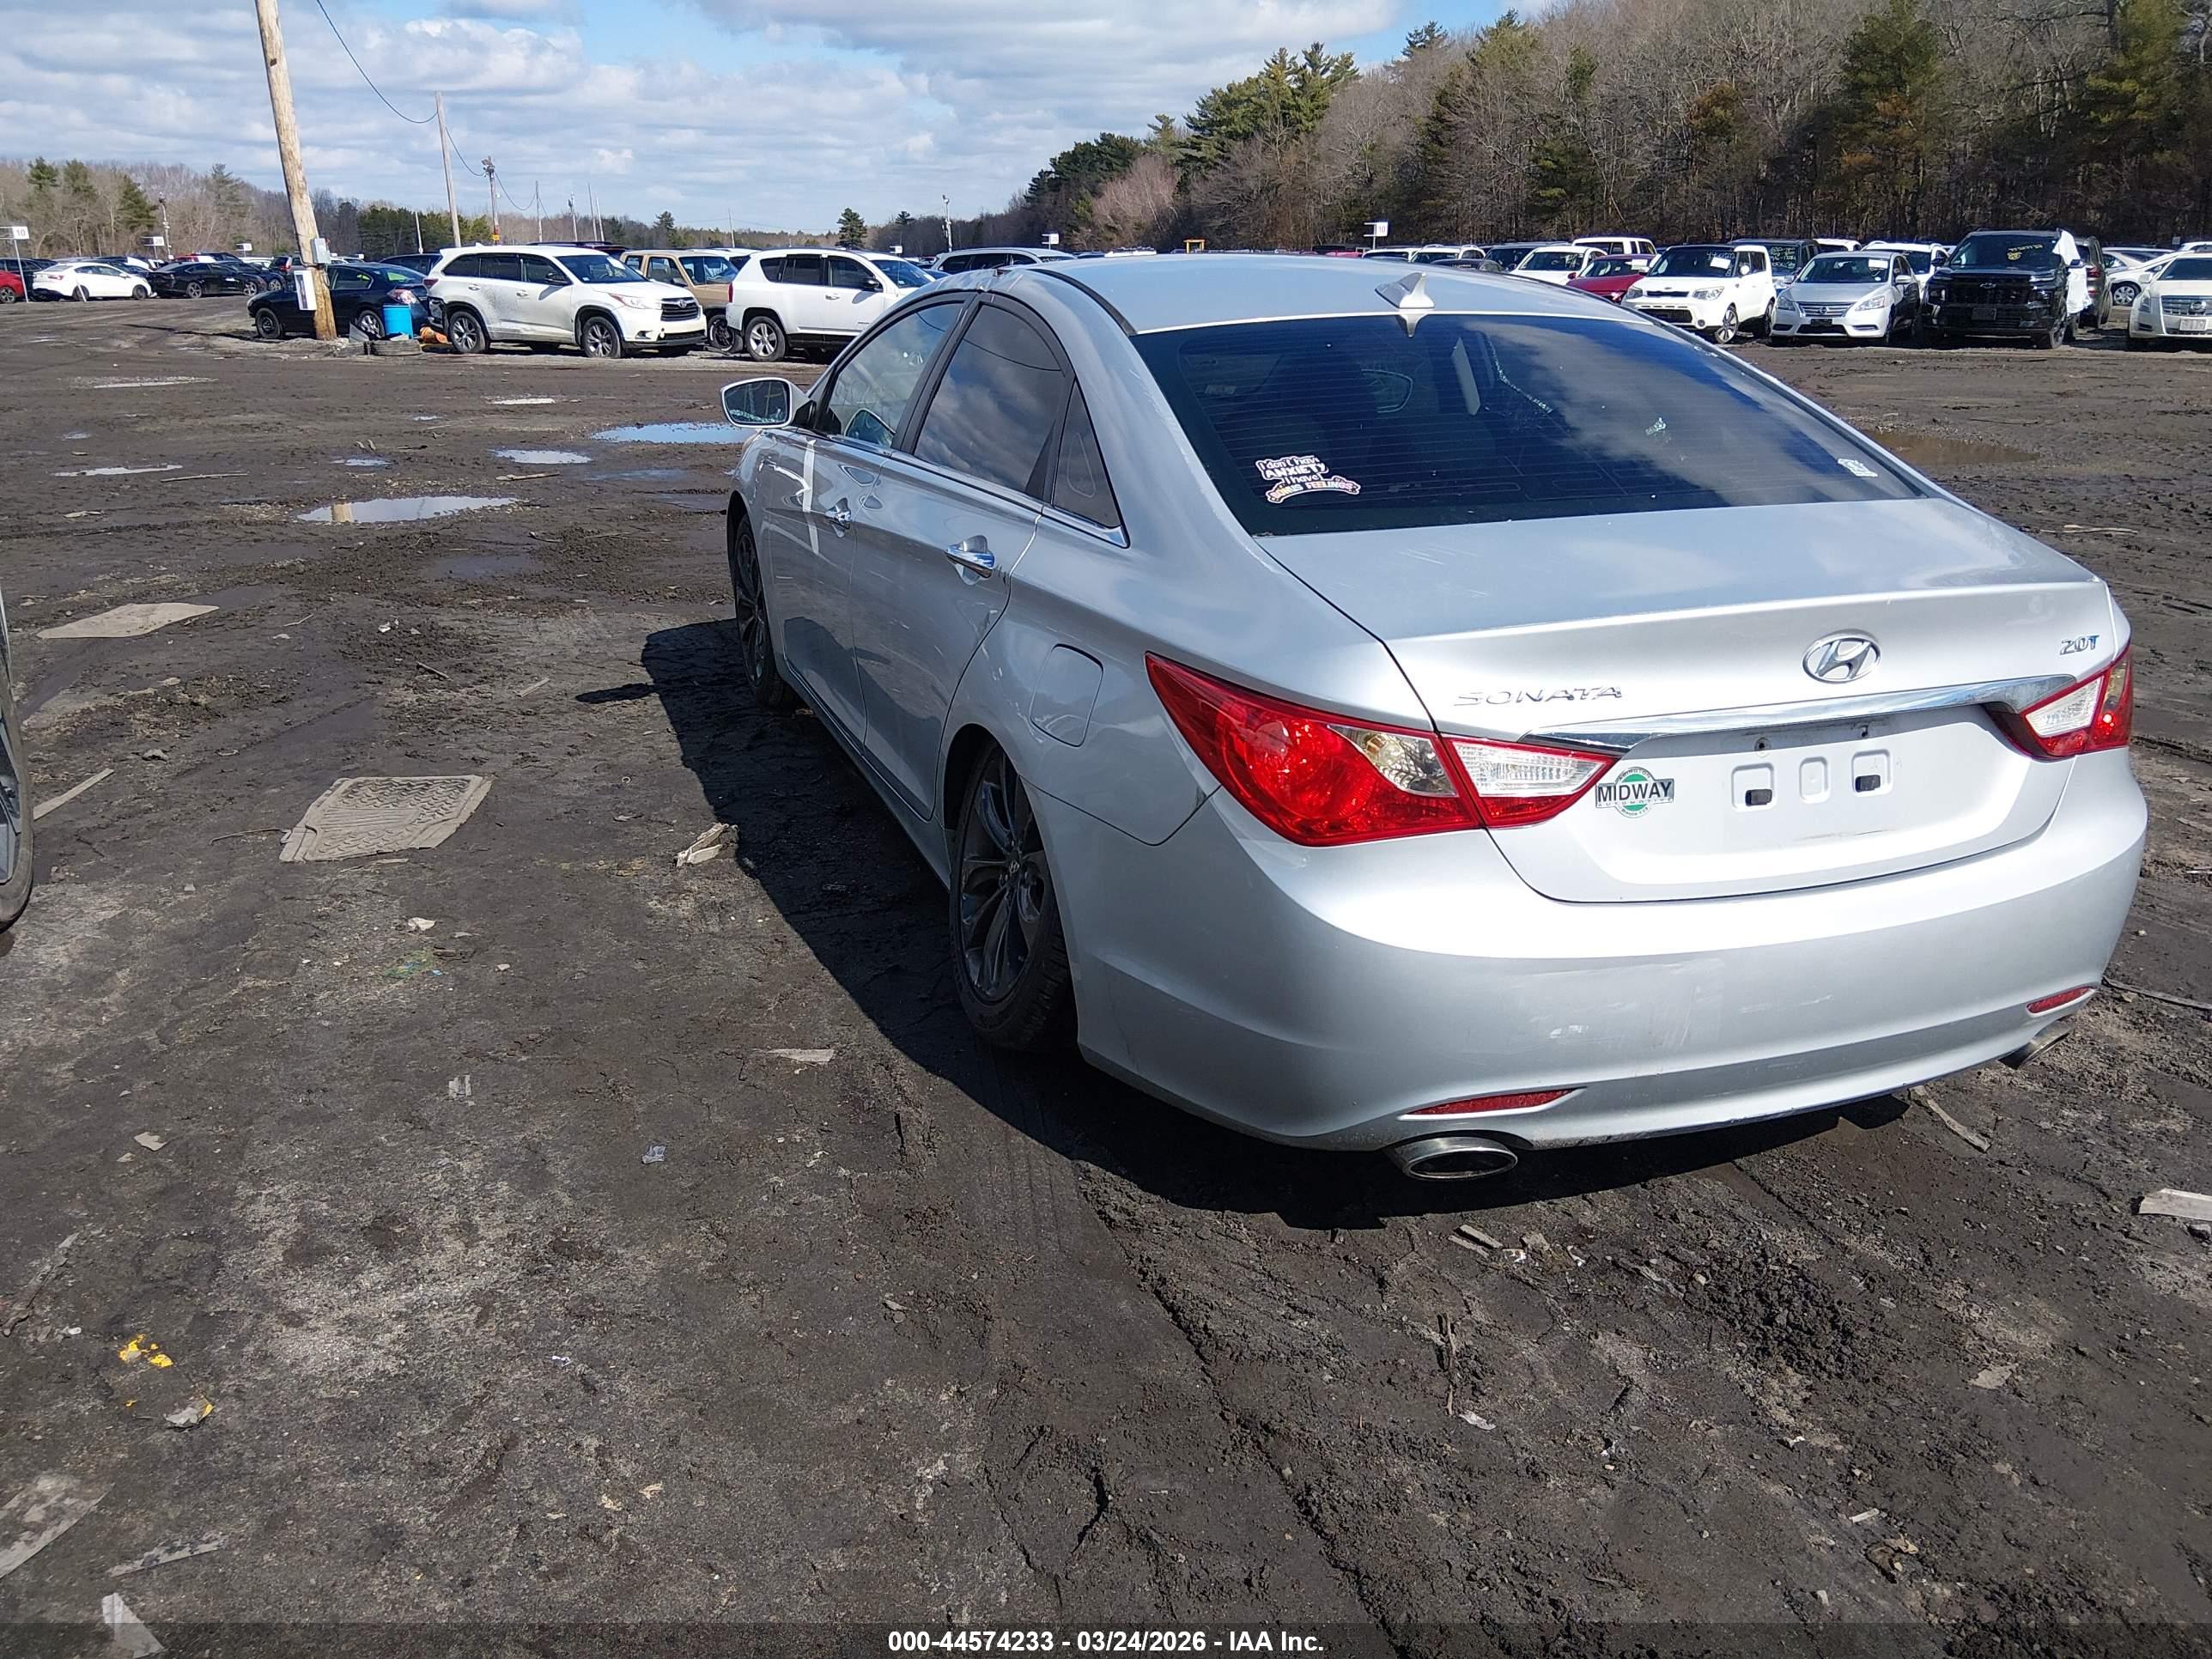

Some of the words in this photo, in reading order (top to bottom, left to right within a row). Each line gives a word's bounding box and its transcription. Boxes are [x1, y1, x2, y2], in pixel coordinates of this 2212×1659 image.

[1265, 463, 1326, 478] ANXIETY
[1290, 474, 1320, 483] have
[1305, 481, 1353, 489] FEELINGS
[1454, 687, 1623, 707] SONATA
[1597, 781, 1672, 803] MIDWAY
